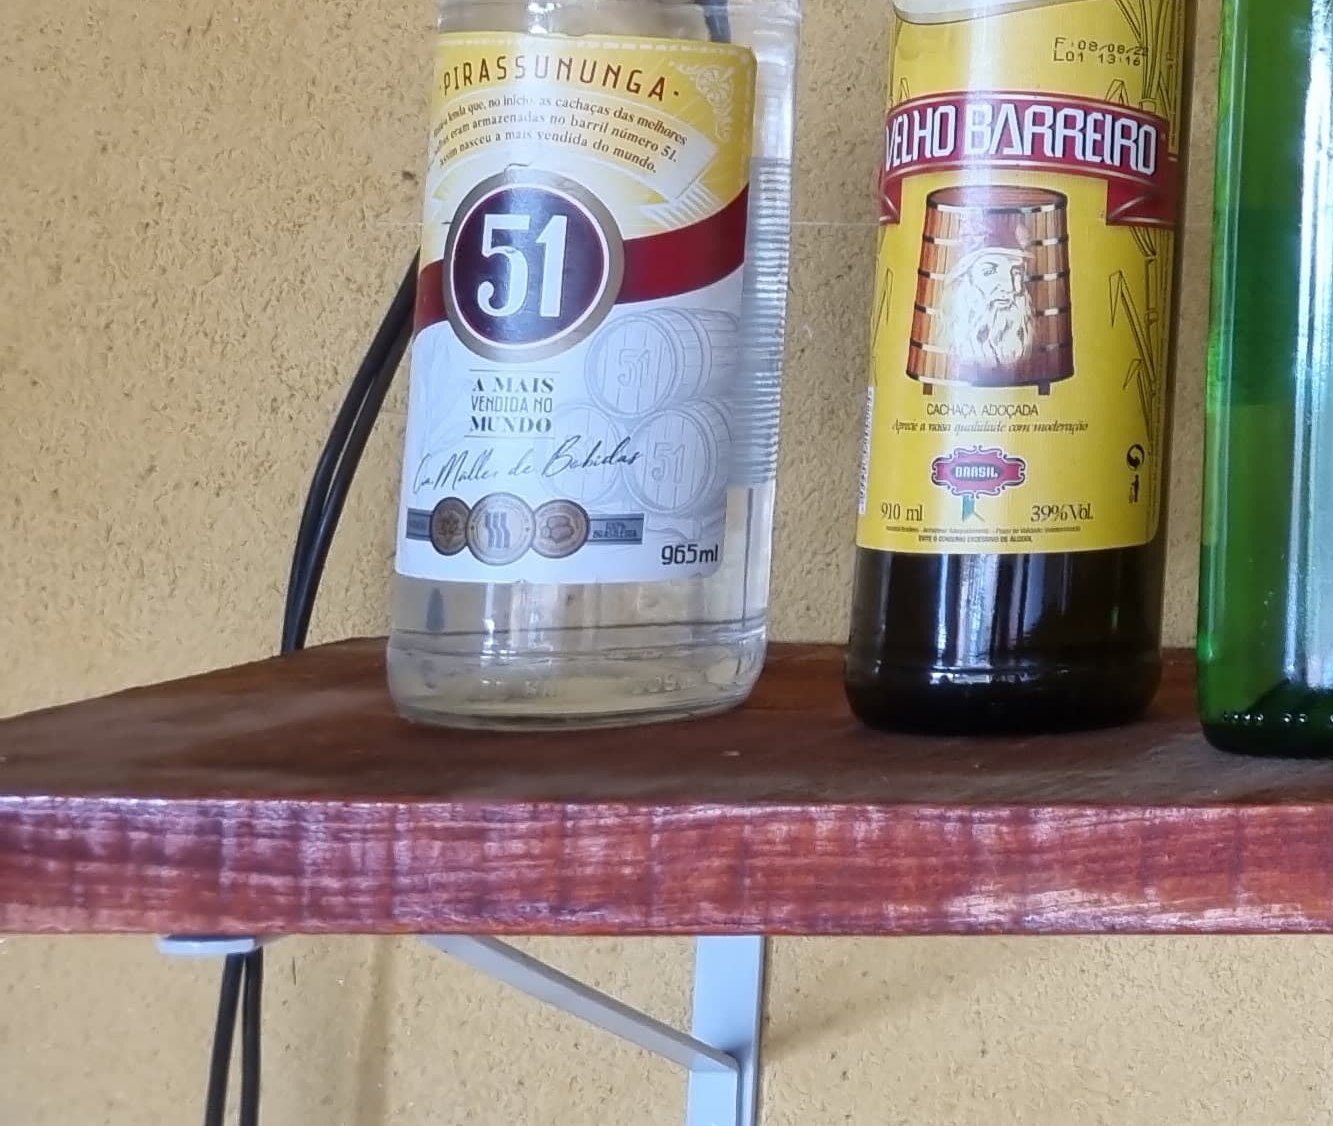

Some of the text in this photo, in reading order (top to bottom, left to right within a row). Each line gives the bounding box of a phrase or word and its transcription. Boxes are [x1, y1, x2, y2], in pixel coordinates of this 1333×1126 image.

[442, 54, 666, 102] PIRASSUNUNGA
[549, 114, 566, 125] no
[570, 113, 609, 134] barril
[611, 124, 659, 152] número
[555, 97, 611, 116] cachaças
[613, 106, 636, 122] das
[636, 115, 688, 147] melhores
[537, 130, 588, 147] vendida
[592, 138, 610, 154] do
[612, 145, 657, 174] mundo.
[885, 101, 1159, 177] VELHO BARREIRO
[477, 212, 568, 318] 51
[471, 376, 554, 393] A MAIS
[471, 394, 553, 414] VENDIDA NO
[926, 402, 1039, 419] CACHAÇA ADOÇADA
[469, 415, 553, 433] MUNDO
[1008, 423, 1031, 432] com
[541, 435, 642, 478] Bebidas
[954, 465, 999, 480] BRASIL
[880, 503, 924, 522] 910 ml
